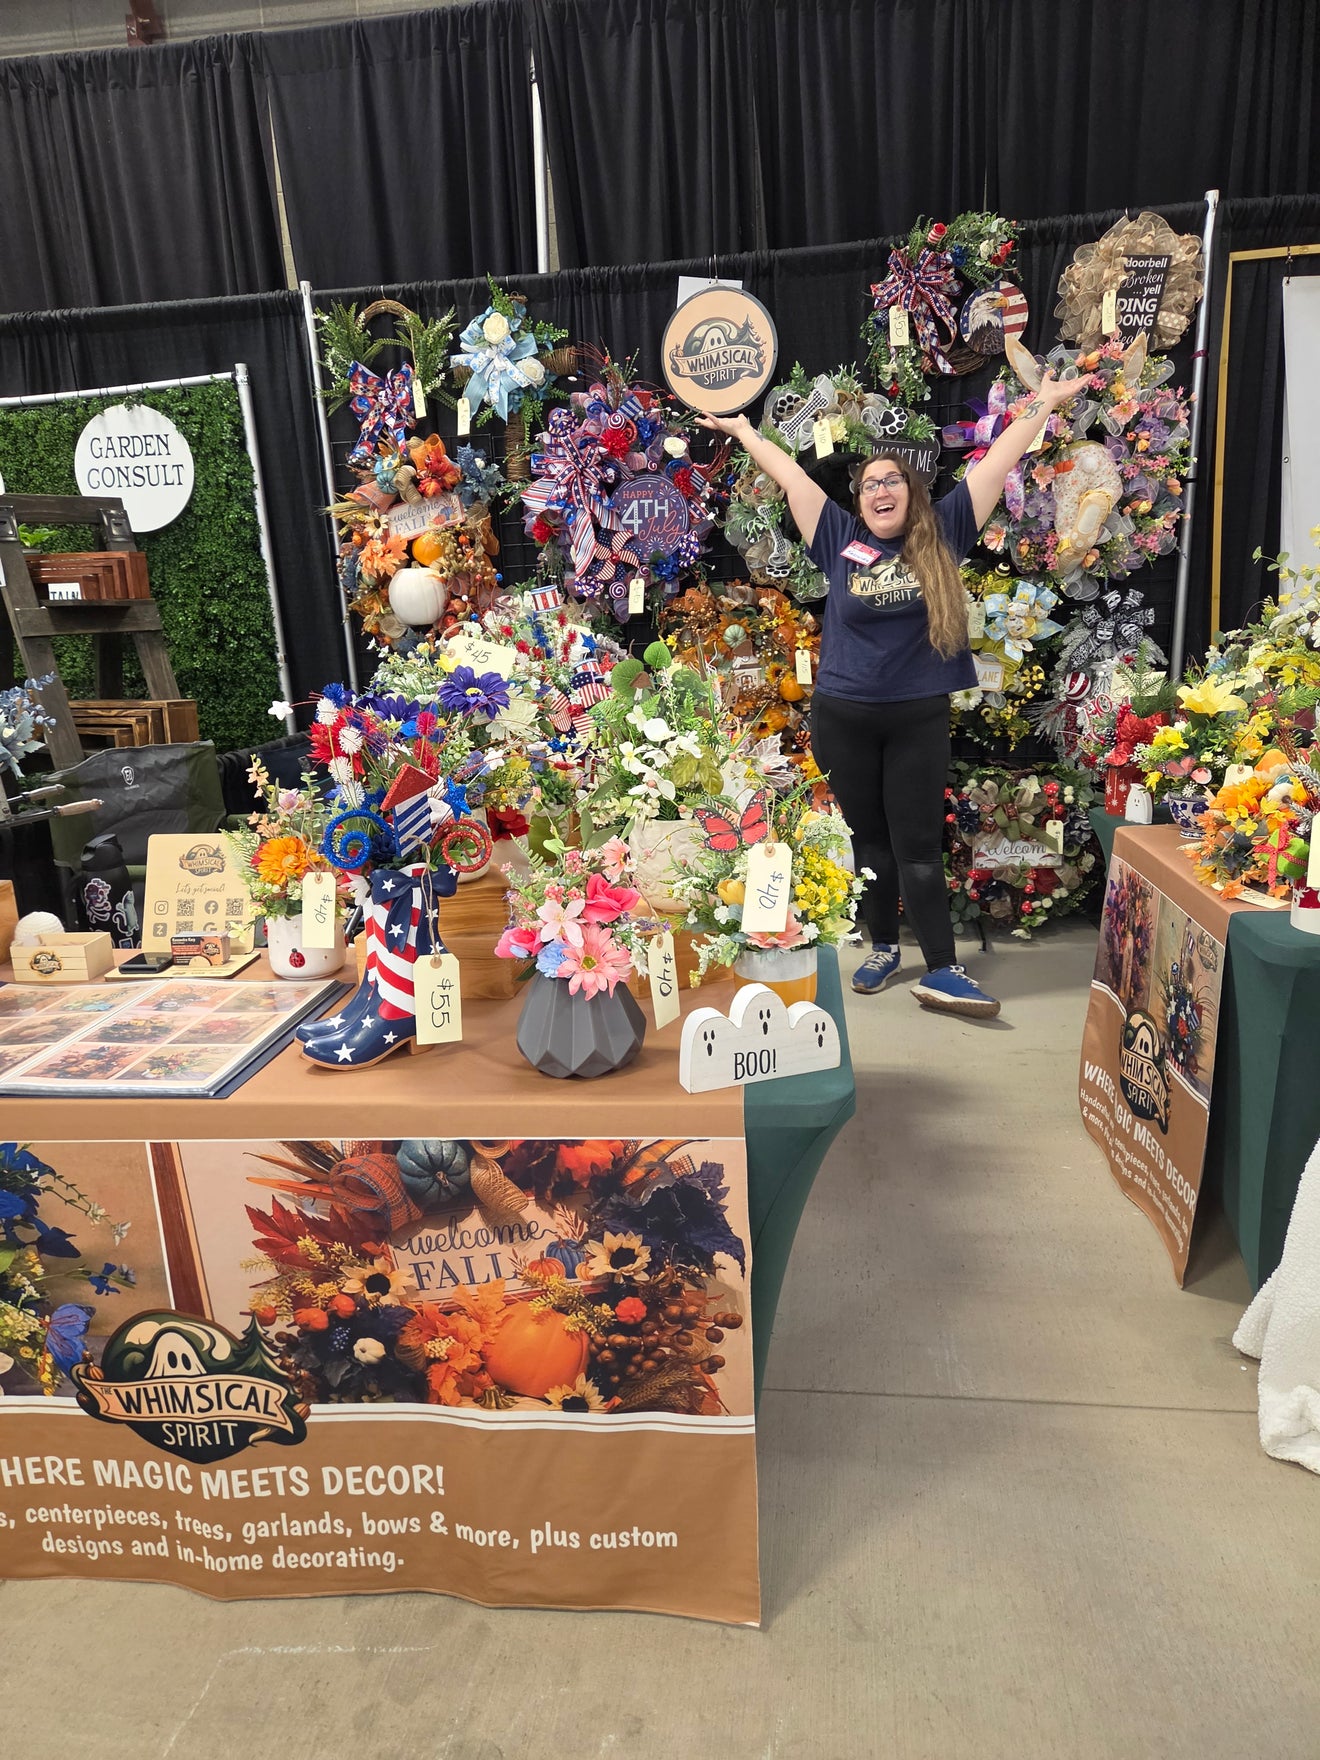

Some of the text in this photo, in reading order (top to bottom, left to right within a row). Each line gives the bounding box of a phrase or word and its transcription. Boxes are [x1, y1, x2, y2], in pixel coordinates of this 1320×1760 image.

[1125, 257, 1168, 268] doorbell
[1120, 268, 1164, 288] Broken
[1117, 298, 1158, 313] DING
[687, 350, 753, 373] WHIMSICAL
[703, 369, 737, 386] SPIRIT
[90, 434, 172, 459] GARDEN
[917, 450, 933, 472] ME
[87, 464, 185, 490] CONSULT
[622, 490, 655, 499] HAPPY
[390, 500, 446, 522] welcome
[621, 499, 669, 535] 4TH
[638, 510, 685, 544] July
[875, 589, 912, 607] SPIRIT
[988, 841, 1047, 857] Welcom
[758, 870, 785, 911] $40
[314, 894, 333, 924] $40
[658, 952, 674, 997] $40
[430, 977, 454, 1028] $55
[733, 1049, 777, 1080] BOO!
[1084, 1060, 1116, 1105] WHERE
[1133, 1121, 1165, 1171] MEETS
[394, 1216, 557, 1256] welcome
[408, 1252, 519, 1292] FALL
[101, 1382, 278, 1417] THE WHIMSICAL
[161, 1422, 239, 1447] SPIRIT
[93, 1458, 193, 1494] MAGIC
[201, 1465, 311, 1500] MEETS
[321, 1464, 445, 1496] DECOR!
[25, 1503, 168, 1531] centerpieces,
[175, 1510, 233, 1543] trees,
[242, 1511, 353, 1545] garlands,
[361, 1512, 421, 1536] bows
[429, 1510, 449, 1536] &
[456, 1520, 519, 1550] more,
[530, 1522, 580, 1554] plus
[589, 1525, 678, 1550] custom
[42, 1530, 405, 1574] designs and in-home decorating.
